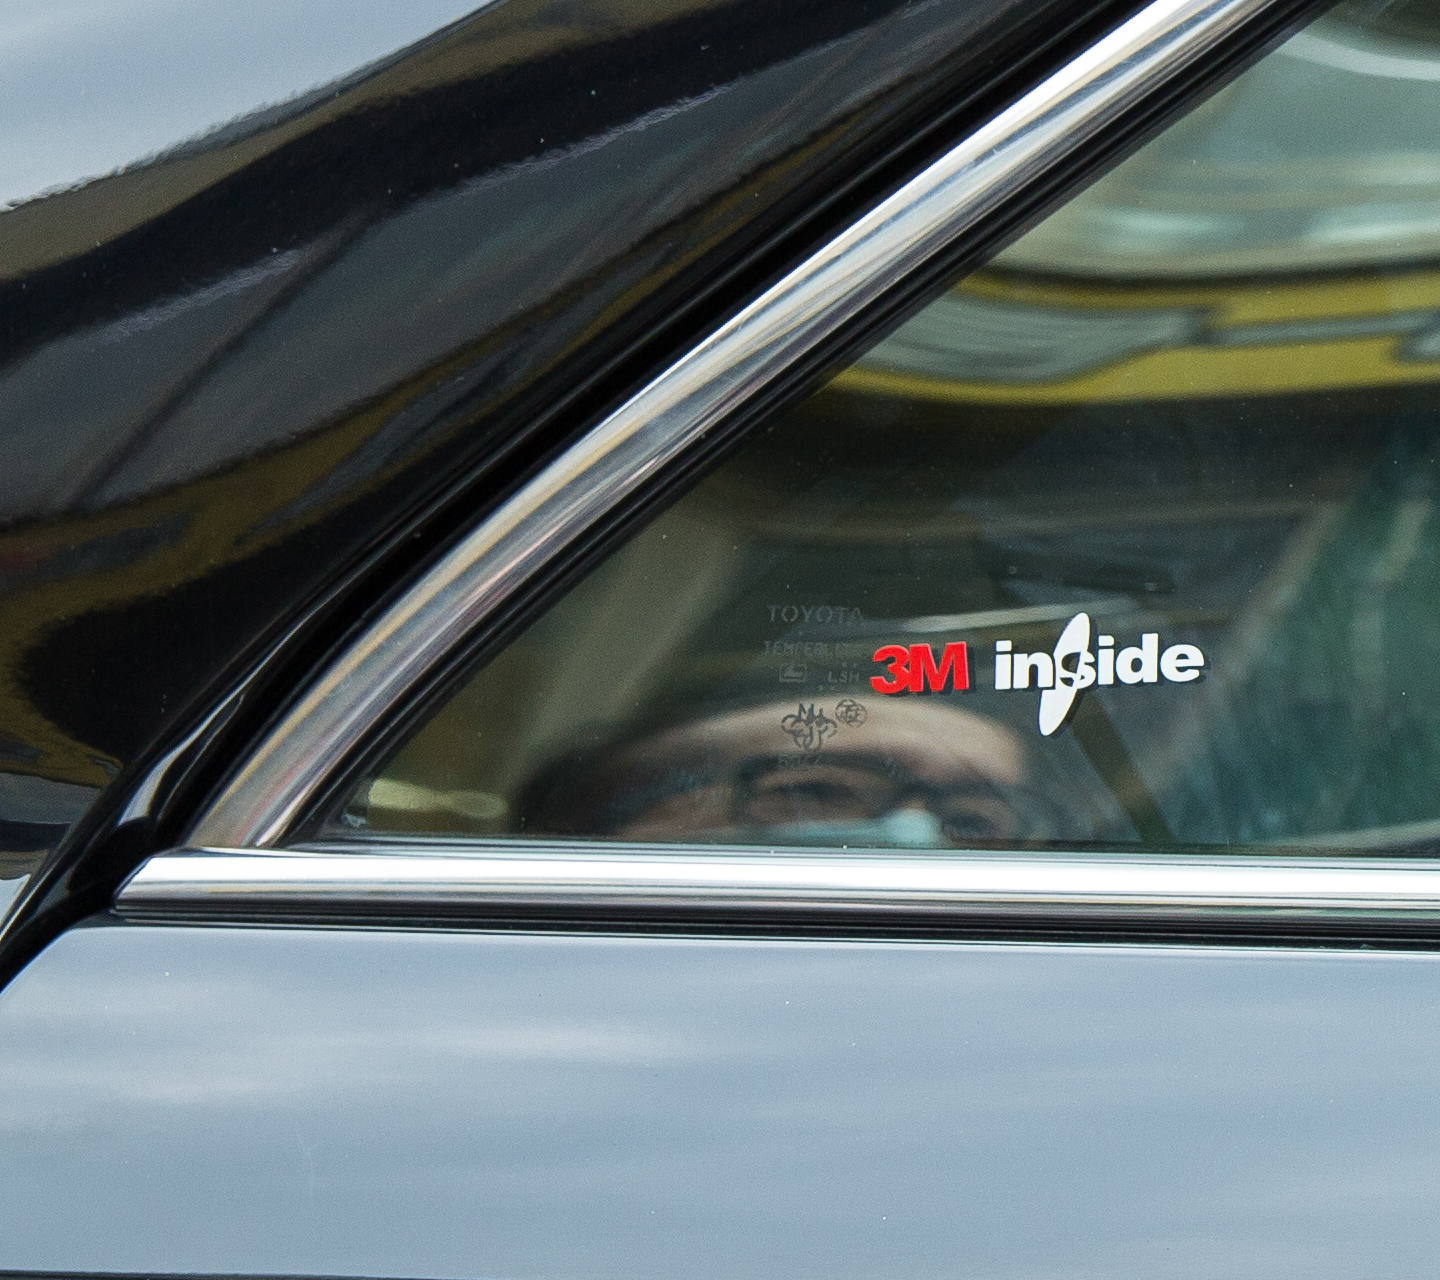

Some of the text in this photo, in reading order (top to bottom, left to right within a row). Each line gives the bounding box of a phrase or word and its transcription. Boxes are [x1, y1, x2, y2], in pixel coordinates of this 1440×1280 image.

[766, 604, 864, 625] TOYOTA
[869, 612, 1206, 737] 3M inside
